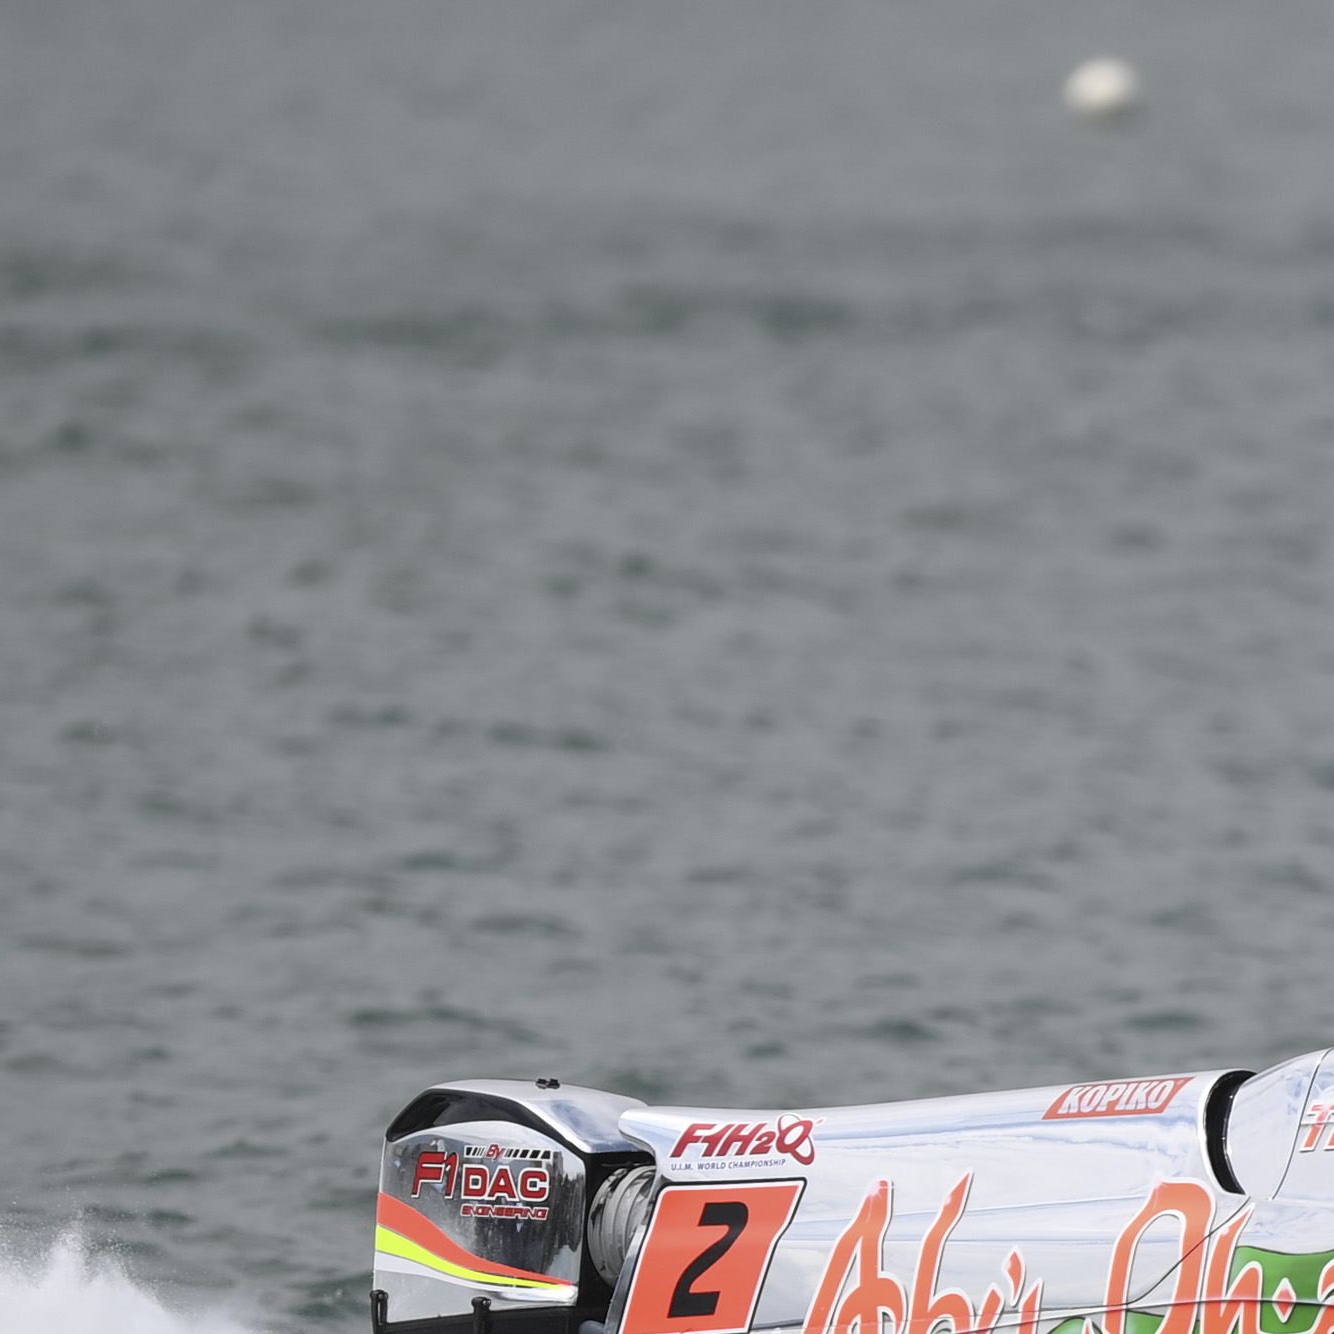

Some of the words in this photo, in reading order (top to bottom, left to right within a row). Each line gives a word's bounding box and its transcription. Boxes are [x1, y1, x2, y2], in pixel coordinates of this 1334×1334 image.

[1056, 1079, 1175, 1115] KOPIKO
[486, 1144, 504, 1160] By
[697, 1162, 726, 1171] WORLD
[728, 1158, 787, 1170] CHAMPIONSHIP
[411, 1150, 459, 1199] F1
[461, 1163, 550, 1202] DAC
[460, 1203, 549, 1220] ENGINEERING
[666, 1200, 749, 1319] 2
